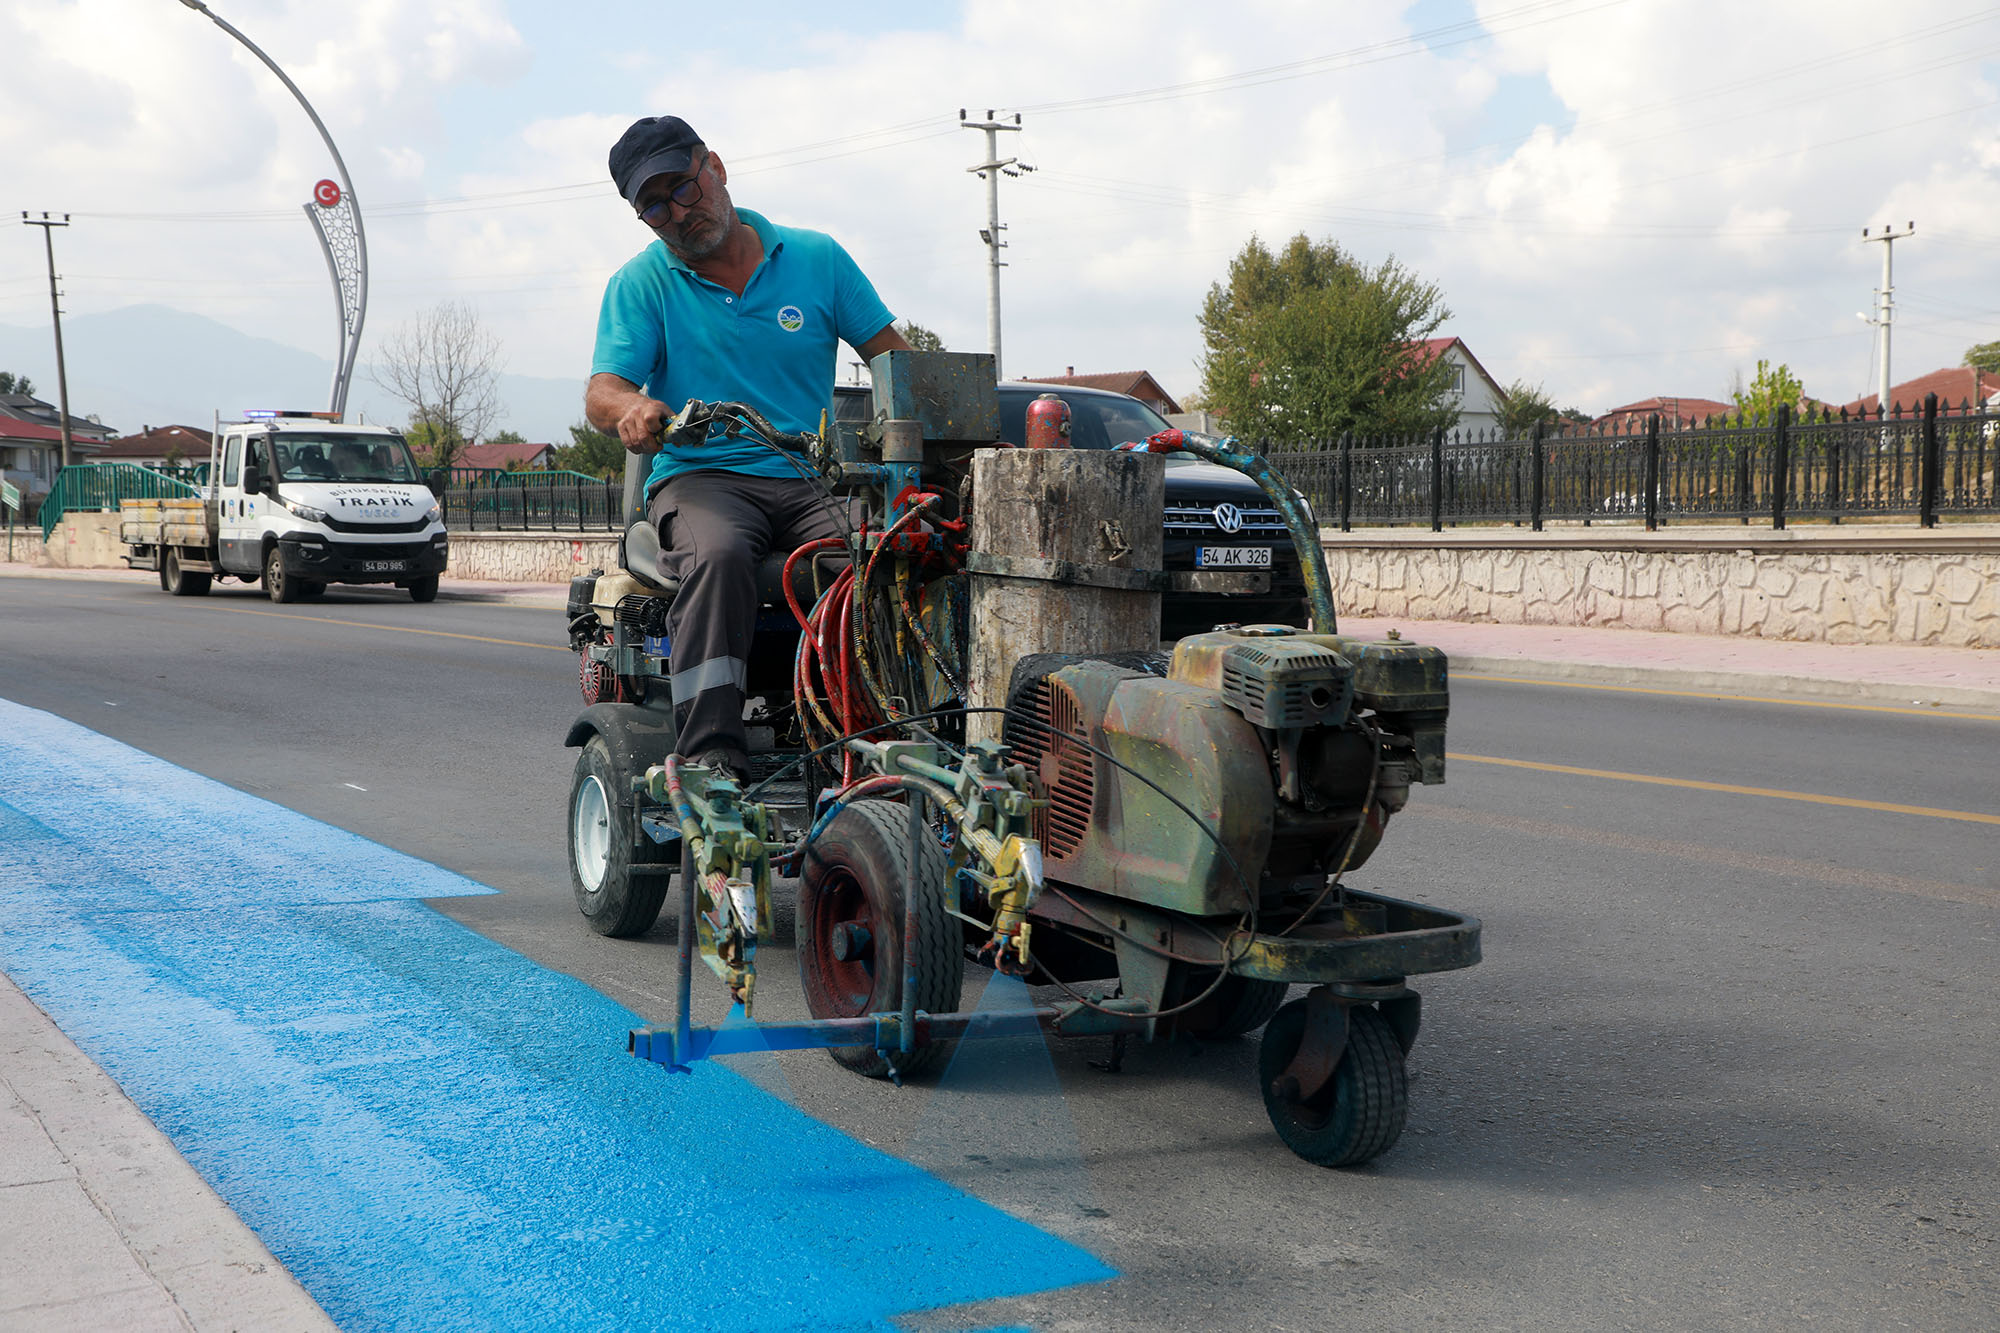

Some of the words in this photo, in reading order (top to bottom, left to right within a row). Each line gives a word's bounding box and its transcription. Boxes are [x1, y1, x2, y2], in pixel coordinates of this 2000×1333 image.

[336, 496, 414, 507] TRAFİK
[1203, 549, 1218, 564] 54
[1224, 549, 1242, 564] AK
[1247, 549, 1268, 564] 326
